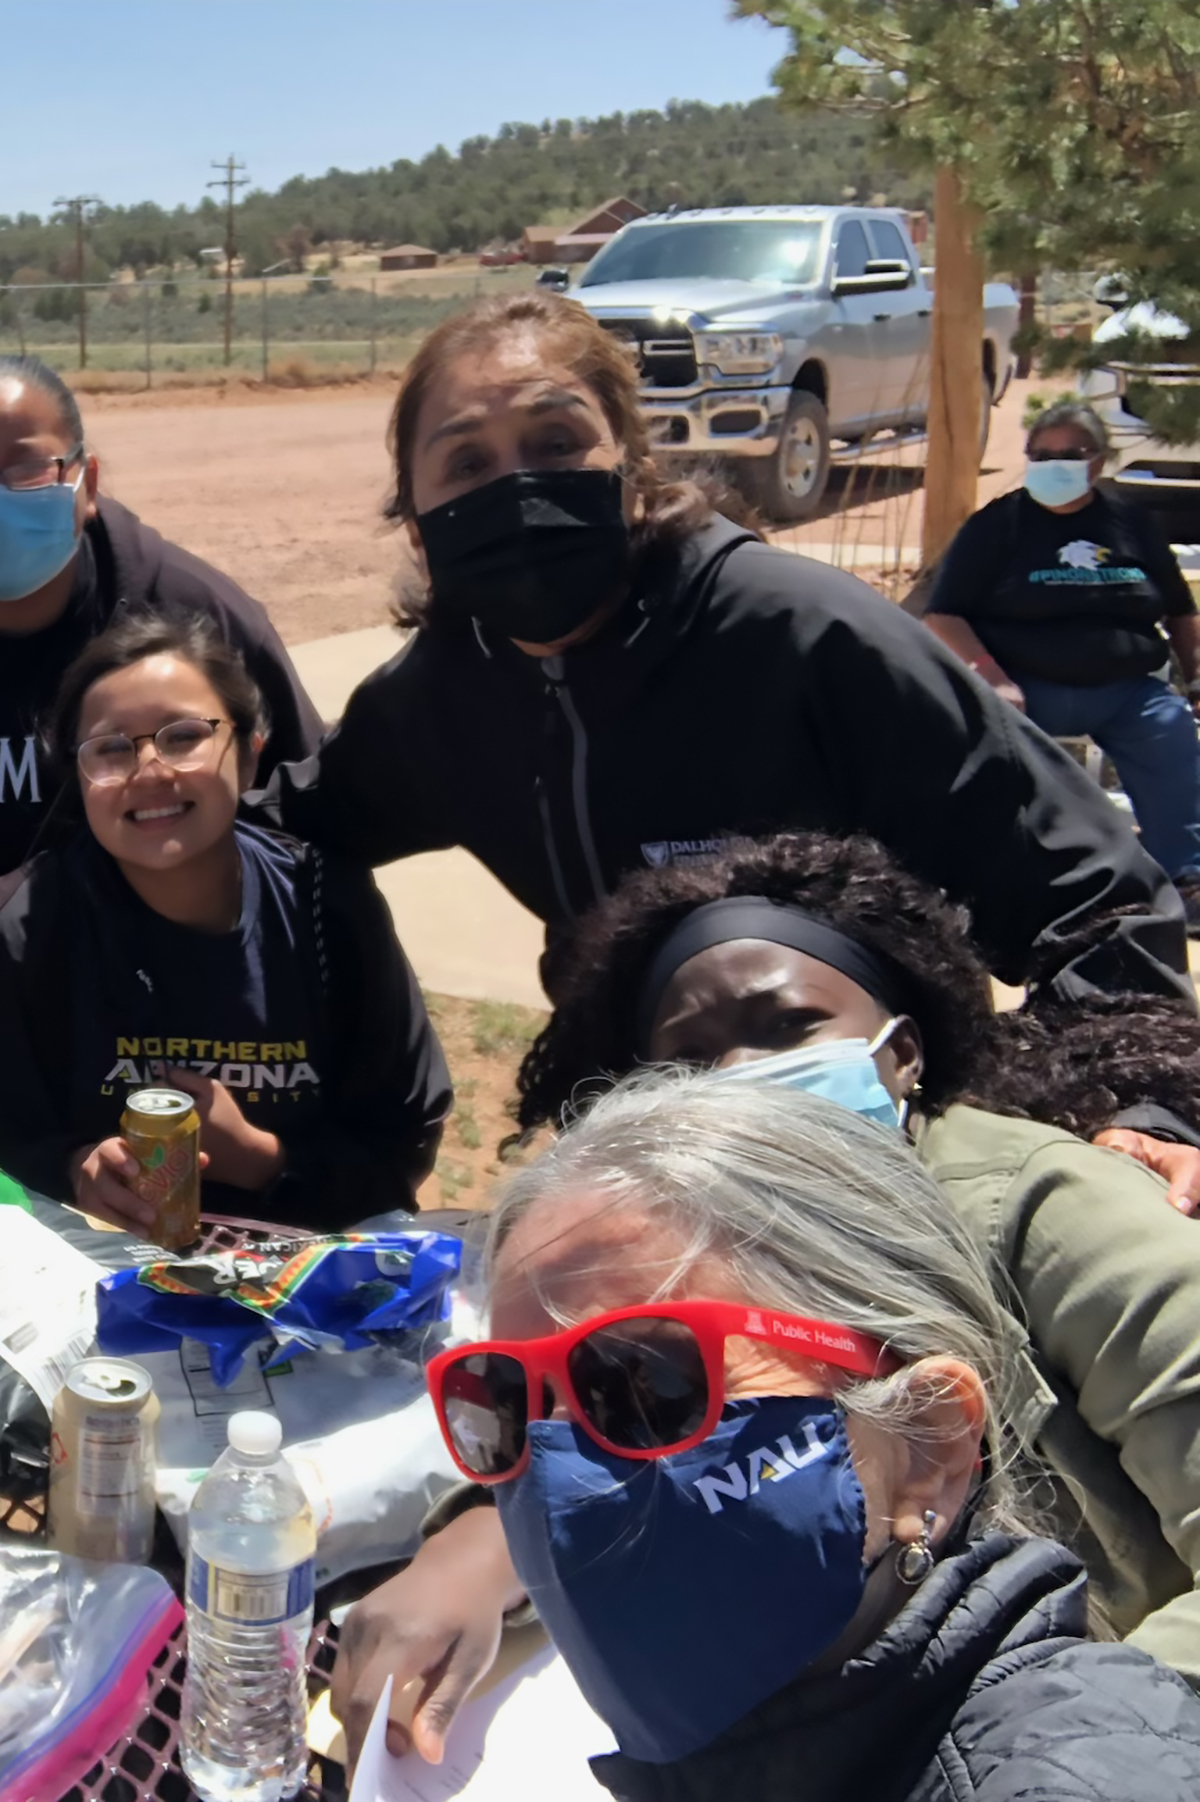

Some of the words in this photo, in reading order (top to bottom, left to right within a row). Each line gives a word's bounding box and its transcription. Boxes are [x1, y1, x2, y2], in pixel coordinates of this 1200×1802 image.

[116, 1036, 307, 1062] NORTHERN
[104, 1058, 321, 1089] AZONA
[772, 1319, 813, 1343] Public
[814, 1329, 857, 1353] Health
[692, 1421, 829, 1515] NAU
